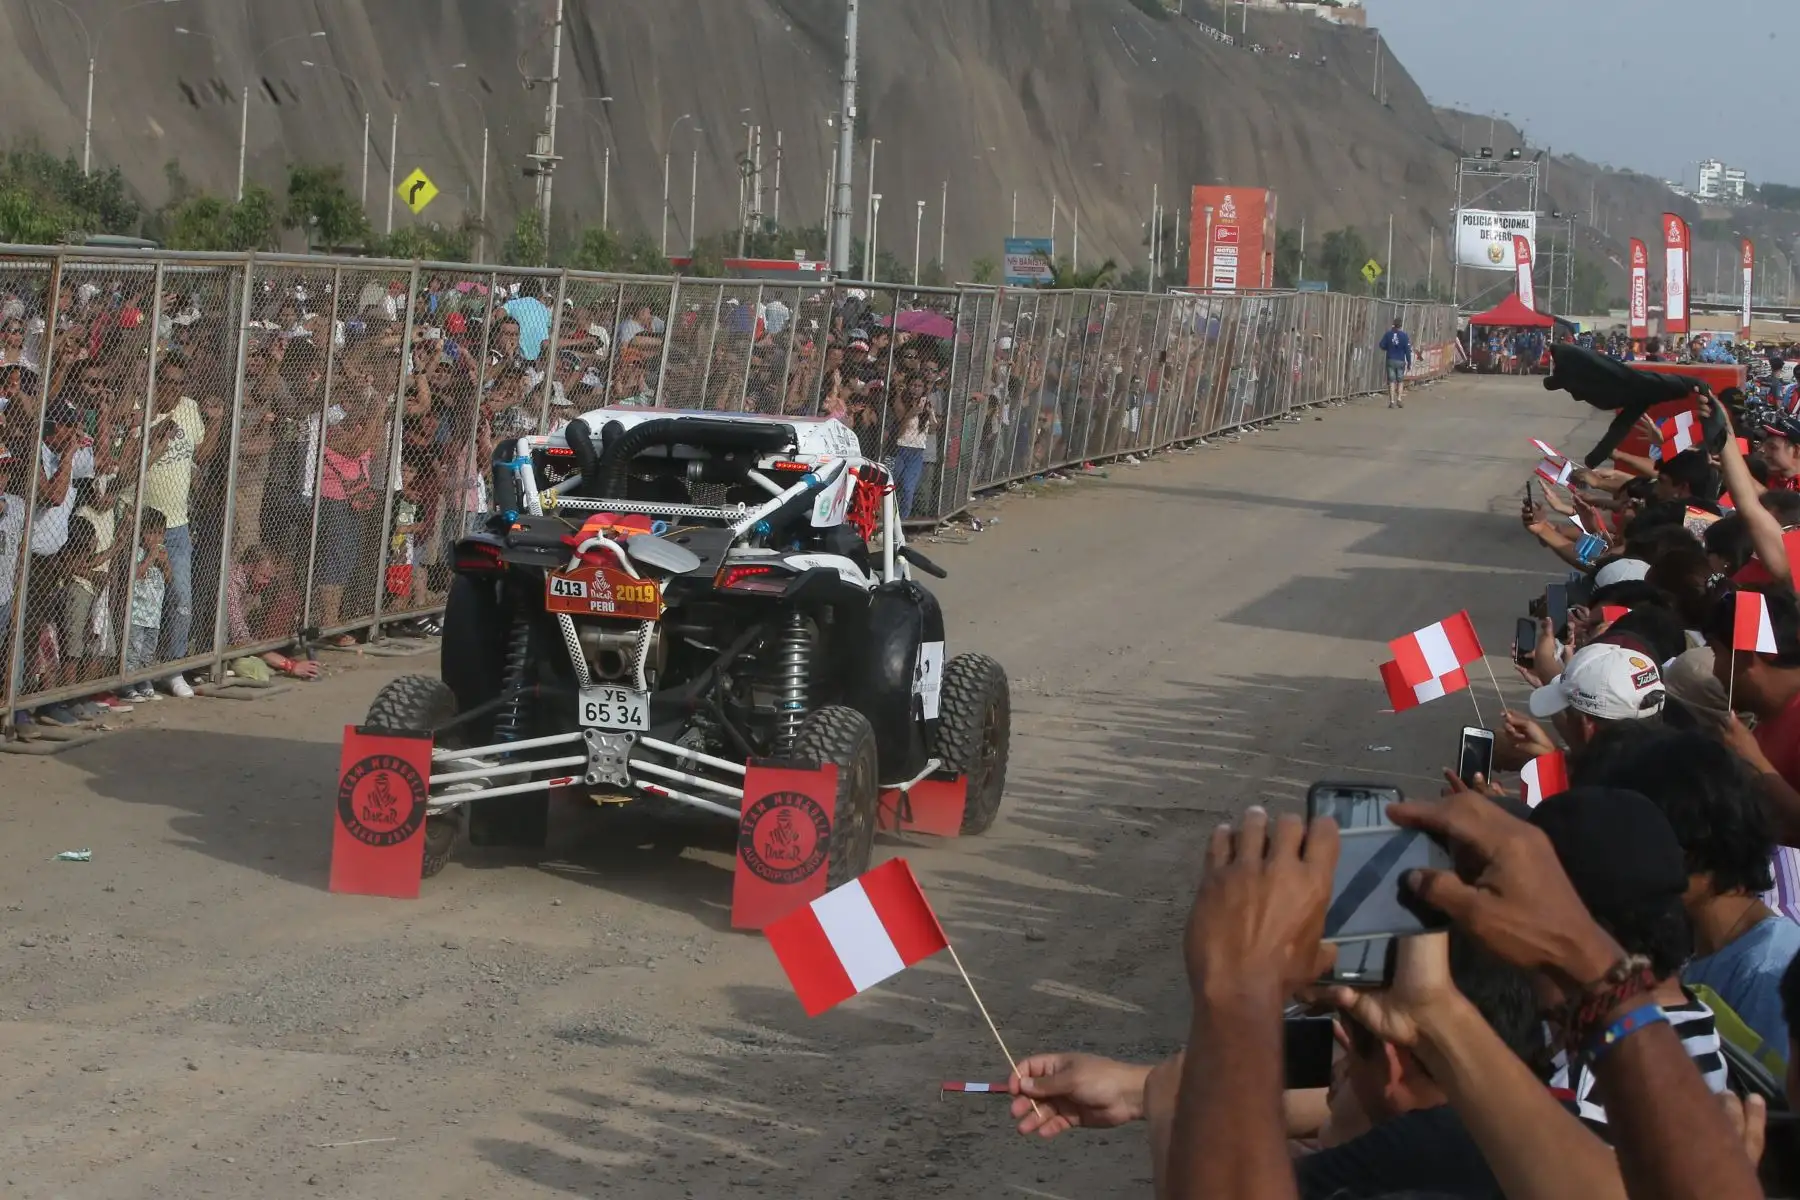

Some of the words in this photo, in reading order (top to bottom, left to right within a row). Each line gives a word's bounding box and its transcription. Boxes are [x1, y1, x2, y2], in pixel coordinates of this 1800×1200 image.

[1494, 217, 1530, 229] NACIONAL
[1634, 277, 1645, 318] MOTUL
[554, 579, 583, 597] 413
[615, 584, 655, 603] 2019
[590, 600, 615, 613] PERÚ
[585, 702, 611, 723] 65
[617, 705, 642, 726] 34
[340, 765, 366, 798] TEAM
[371, 757, 425, 803] MONGOLIA
[741, 801, 767, 836] TEAM
[773, 794, 829, 839] MONGOLIA
